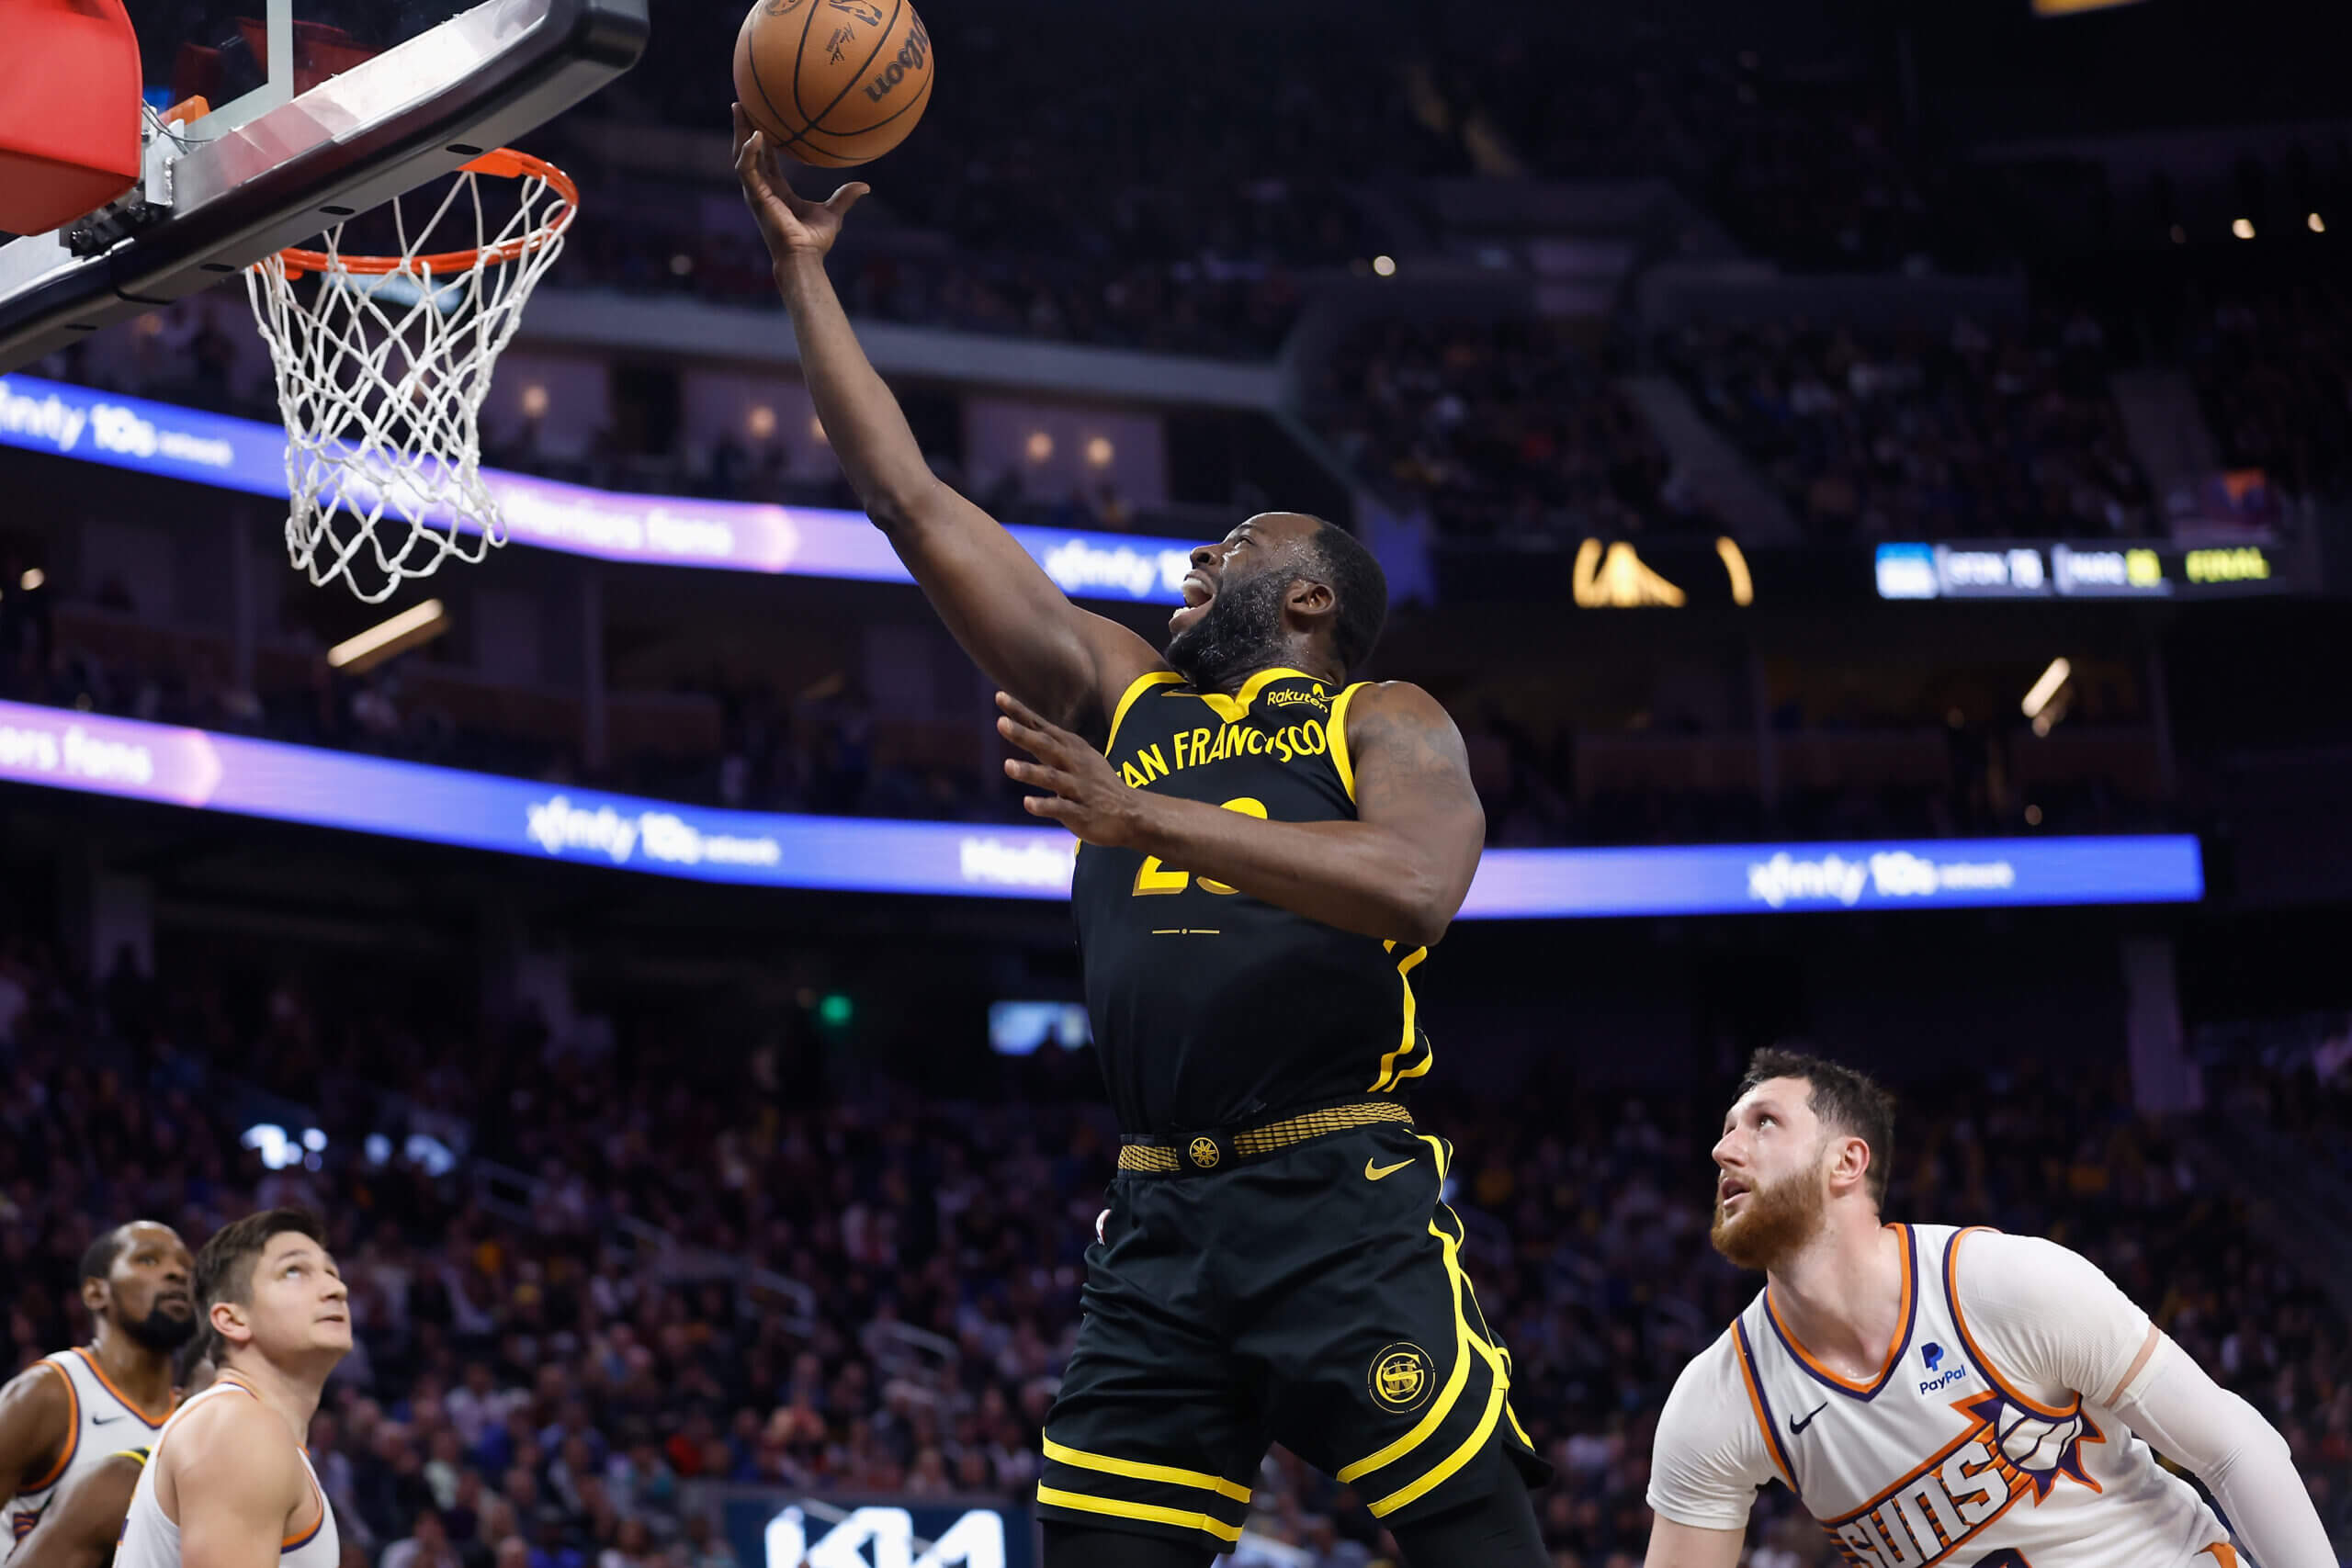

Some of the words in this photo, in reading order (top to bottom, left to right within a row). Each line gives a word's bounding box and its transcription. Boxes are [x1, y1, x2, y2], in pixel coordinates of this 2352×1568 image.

[1267, 688, 1329, 714] Rakuten
[1117, 742, 1170, 789] AN
[1173, 719, 1327, 770] FRANCISCO
[1919, 1365, 1967, 1395] PayPal
[1838, 1439, 2009, 1568] SUNS
